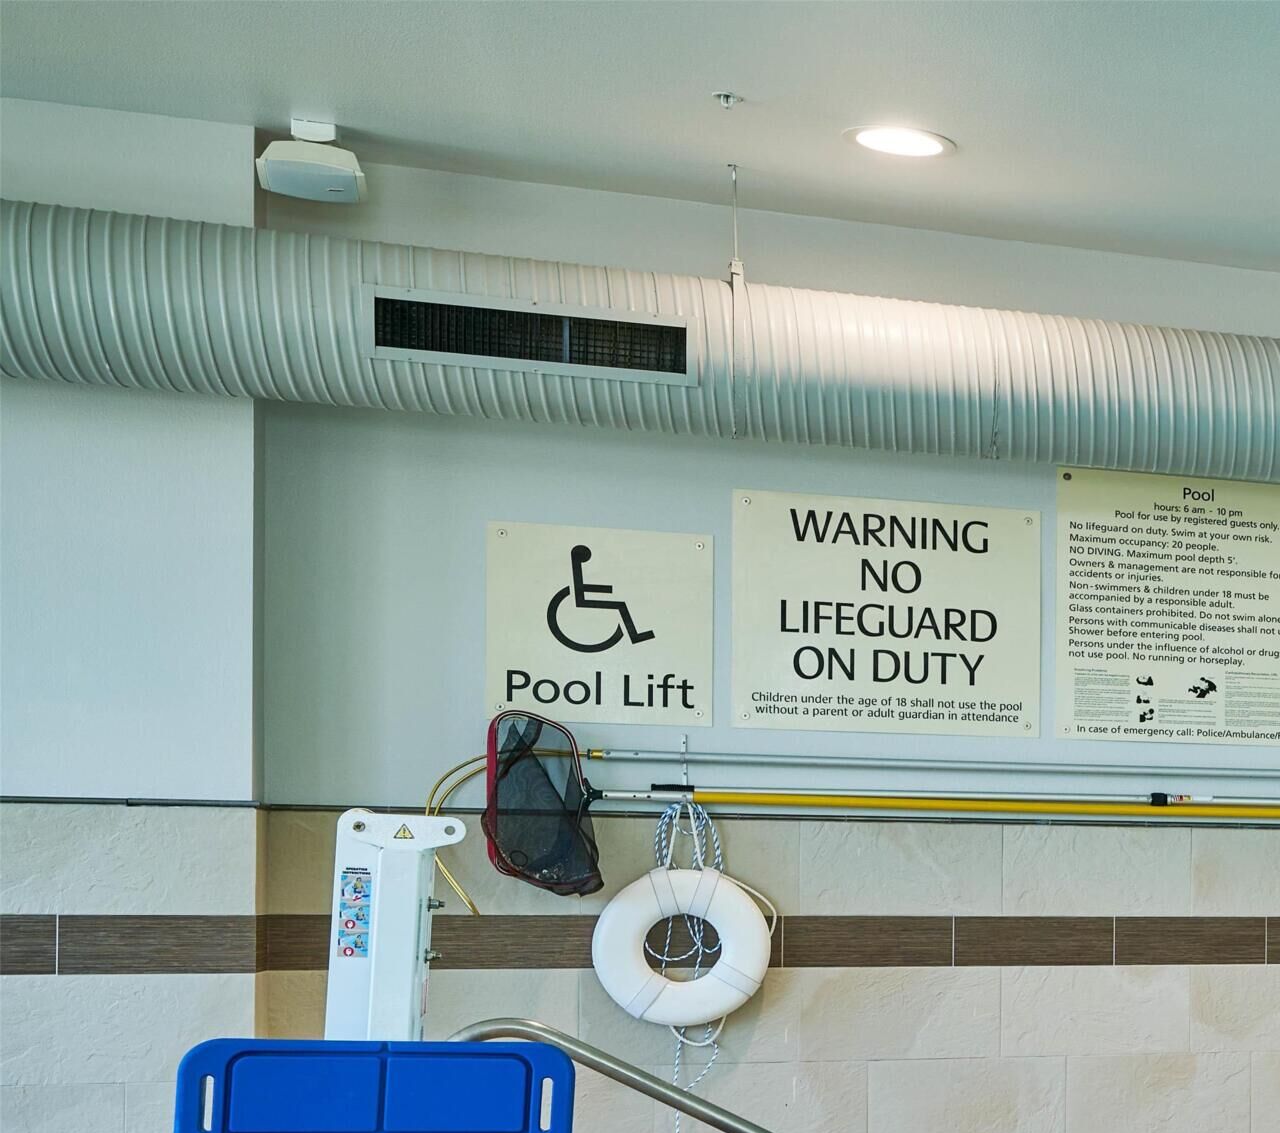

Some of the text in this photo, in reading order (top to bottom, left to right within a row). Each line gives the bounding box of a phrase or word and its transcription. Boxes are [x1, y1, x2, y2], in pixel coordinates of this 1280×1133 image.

[1183, 488, 1215, 501] Pool
[1154, 502, 1181, 512] hours:
[1183, 504, 1190, 513] 6
[1217, 507, 1226, 515] 10
[1228, 509, 1243, 518] pm
[1115, 510, 1134, 520] Pool
[1137, 512, 1150, 521] for
[1171, 514, 1182, 525] by
[1184, 516, 1228, 526] registered
[1230, 520, 1258, 529] guests
[1259, 521, 1280, 532] only.
[790, 508, 989, 554] WARNING
[1069, 521, 1084, 530] No
[1085, 522, 1129, 534] lifeguard
[1145, 526, 1169, 538] duty.
[1171, 528, 1196, 538] Swim
[1198, 530, 1208, 539] at
[1209, 533, 1230, 542] your
[1254, 534, 1272, 543] risk.
[1069, 534, 1220, 552] Maximum occupancy: 20 people.
[1069, 546, 1085, 555] NO
[1087, 547, 1124, 557] DIVING.
[1126, 549, 1173, 560] Maximum
[1175, 553, 1196, 563] pool
[1197, 554, 1225, 565] depth
[861, 560, 922, 594] NO
[1069, 558, 1105, 568] Owners
[1108, 561, 1115, 569] &
[1118, 564, 1179, 573] management
[1198, 567, 1214, 575] not
[1217, 569, 1267, 578] responsible
[1069, 569, 1113, 579] accidents
[1128, 572, 1164, 583] injuries.
[1069, 594, 1131, 604] accompanied
[1133, 595, 1145, 606] by
[1155, 598, 1206, 608] responsible
[1208, 599, 1235, 608] adult.
[1143, 585, 1150, 594] &
[1153, 586, 1190, 596] children
[1193, 589, 1220, 598] under
[1222, 590, 1232, 598] 18
[1234, 591, 1256, 600] must
[1258, 592, 1270, 600] be
[781, 599, 998, 642] LIFEGUARD
[1069, 604, 1093, 613] Glass
[1095, 606, 1144, 616] containers
[1146, 608, 1196, 618] prohibited.
[1199, 611, 1213, 619] Do
[1215, 612, 1230, 620] not
[1232, 613, 1256, 622] swim
[1069, 616, 1105, 625] Persons
[1106, 618, 1128, 627] with
[1130, 621, 1197, 630] communicable
[1199, 622, 1236, 633] diseases
[1237, 625, 1258, 634] shall
[1260, 626, 1276, 635] not
[1069, 626, 1204, 643] Shower before entering pool.
[1069, 638, 1104, 648] Persons
[1107, 641, 1134, 650] under
[1137, 642, 1152, 651] the
[1155, 643, 1198, 653] influence
[1199, 645, 1210, 653] of
[1212, 646, 1244, 655] alcohol
[793, 645, 985, 686] ON DUTY
[1068, 649, 1085, 657] not
[1106, 651, 1130, 661] pool.
[1132, 652, 1146, 660] No
[1148, 654, 1185, 665] running
[1199, 655, 1245, 668] horseplay.
[506, 669, 695, 710] Pool Lift
[751, 692, 798, 703] Children
[801, 695, 834, 704] under
[836, 696, 855, 705] the
[857, 698, 878, 708] age
[880, 697, 892, 706] of
[895, 698, 908, 707] 18
[910, 698, 934, 708] shall
[937, 700, 956, 709] not
[979, 701, 997, 710] the
[999, 702, 1023, 713] pool
[755, 704, 799, 715] without
[812, 707, 848, 718] parent
[867, 708, 895, 718] adult
[898, 710, 945, 721] guardian
[948, 711, 958, 720] in
[961, 712, 1019, 722] attendance
[1077, 724, 1086, 732] In
[1110, 725, 1121, 734] of
[1123, 728, 1174, 738] emergency
[1176, 728, 1194, 736] call:
